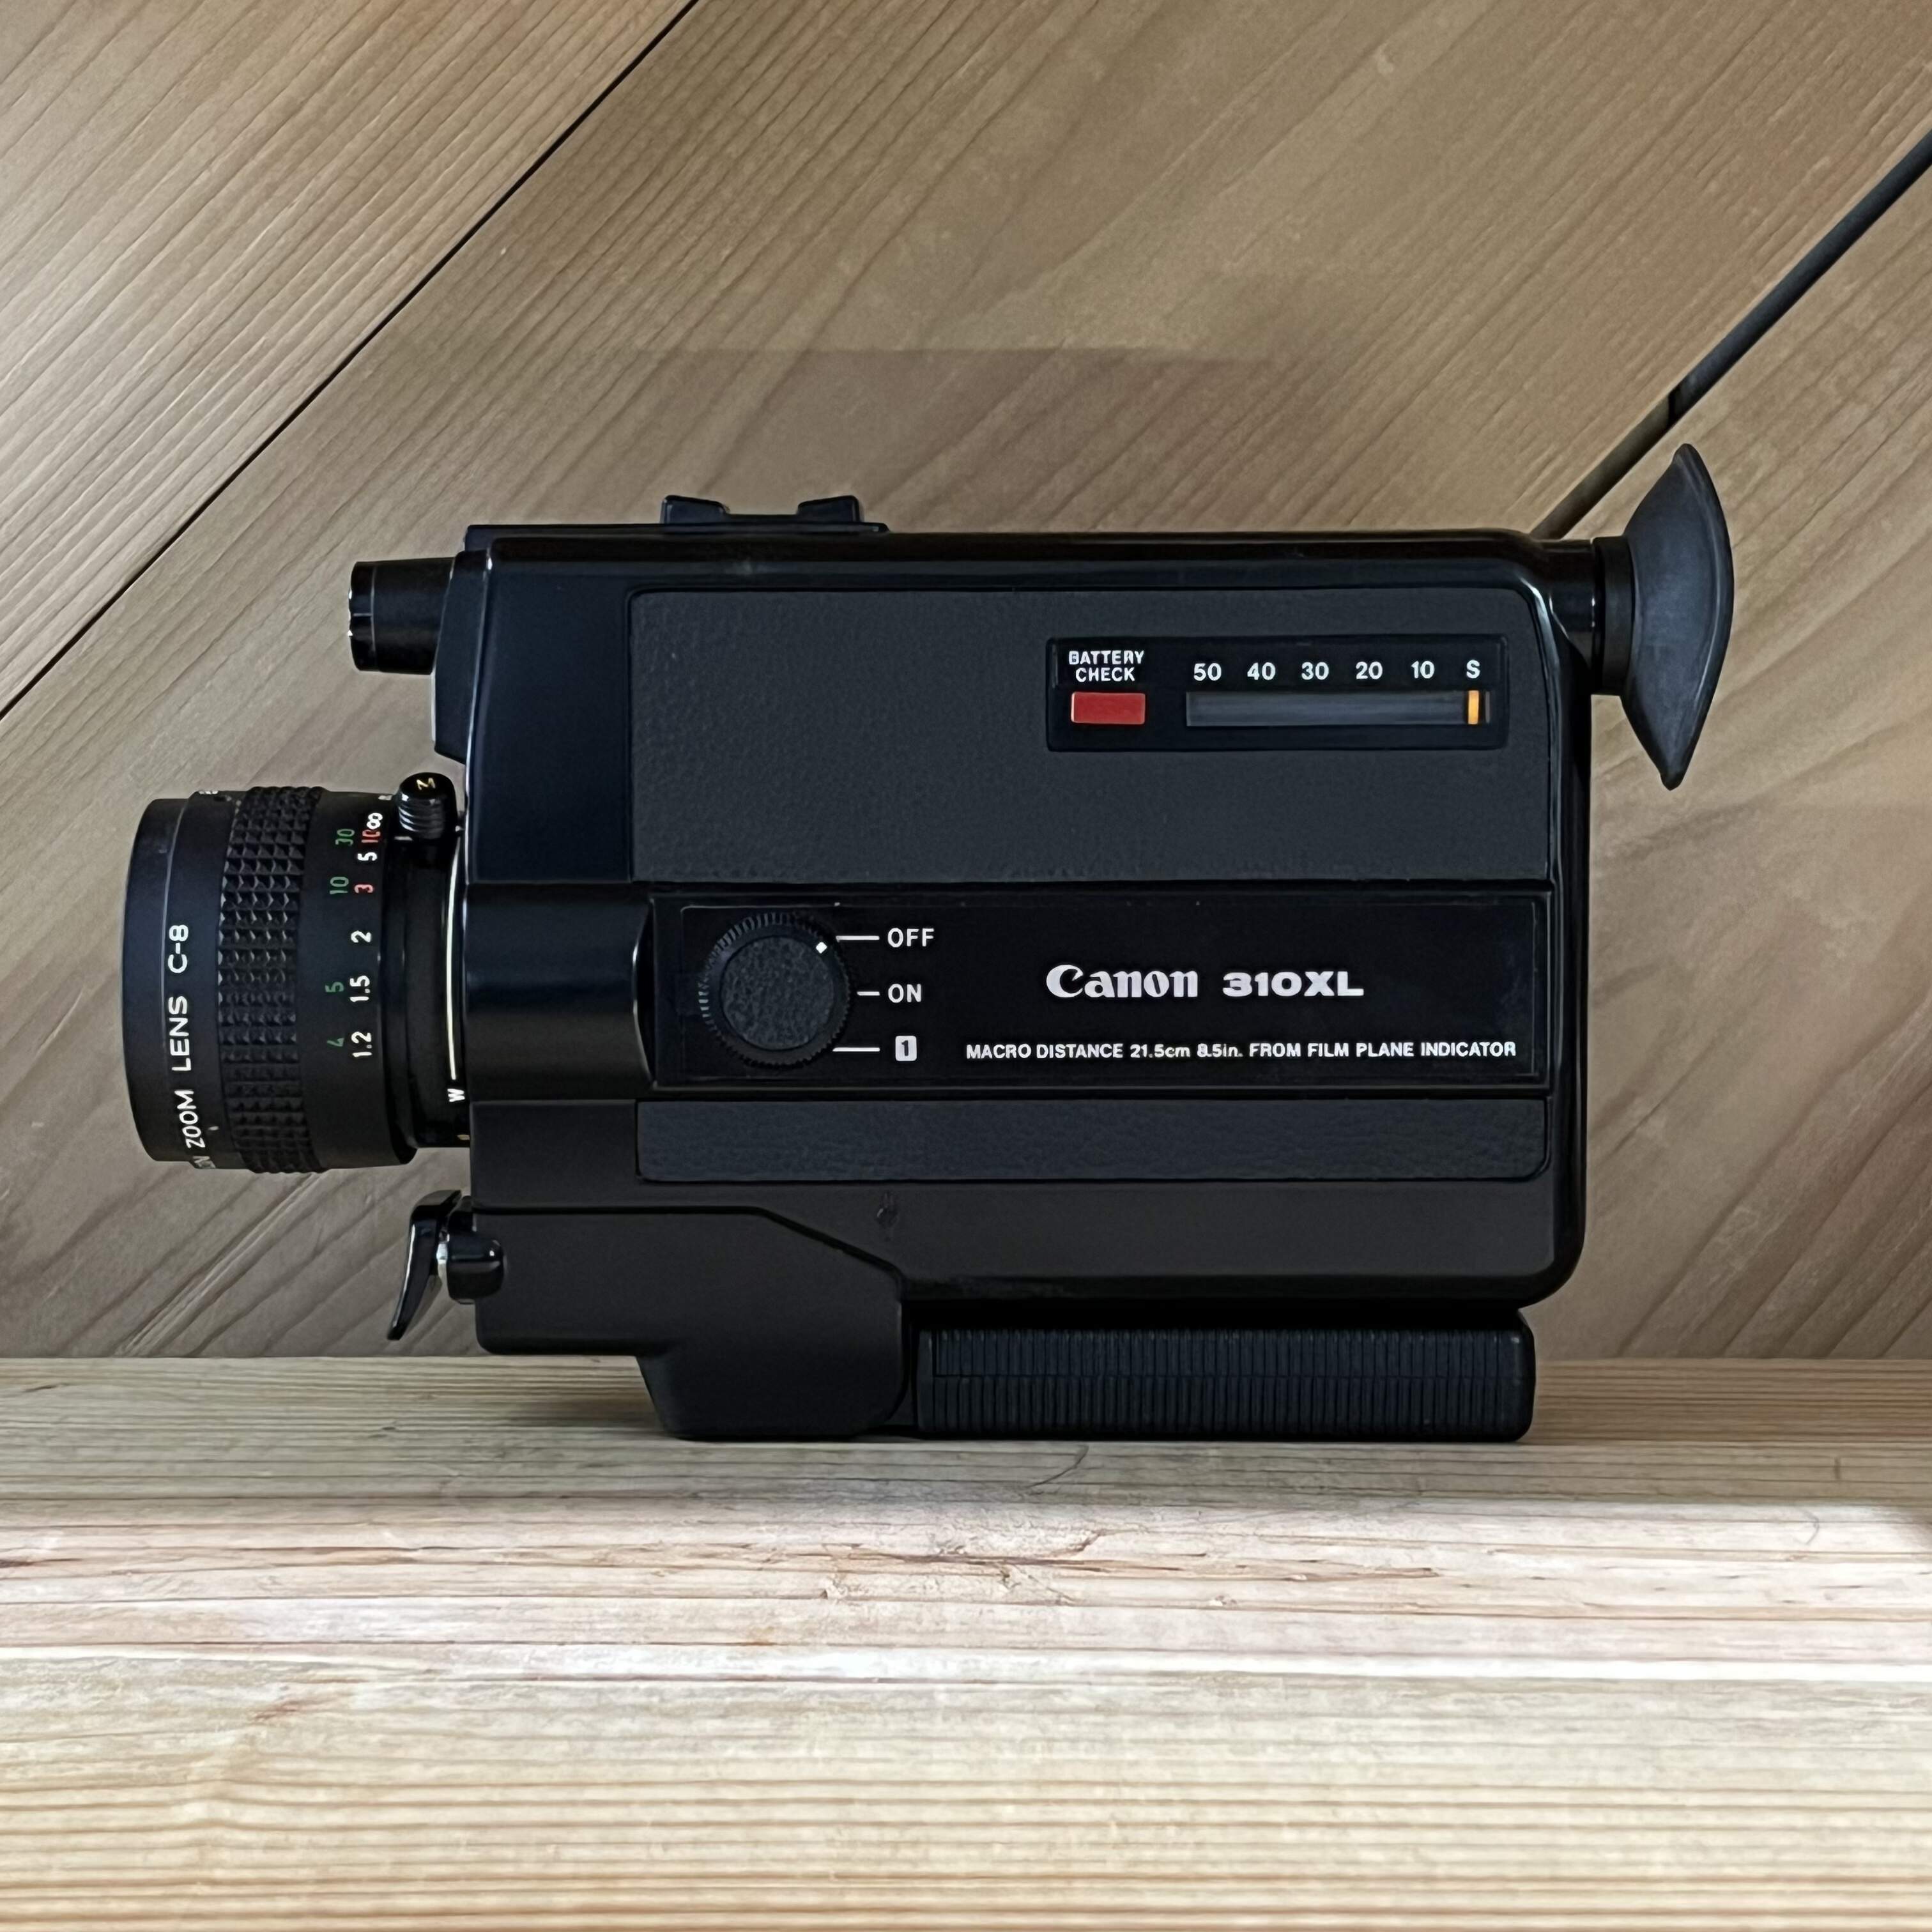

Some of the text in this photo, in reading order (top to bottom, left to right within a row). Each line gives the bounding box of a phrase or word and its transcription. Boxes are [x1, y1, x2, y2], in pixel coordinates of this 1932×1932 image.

[1068, 650, 1144, 665] BATTERY
[1075, 666, 1135, 682] CHECK
[1193, 659, 1480, 682] 50 40 30 20 10 S
[335, 829, 355, 847] 30
[357, 852, 378, 861] 5
[329, 876, 349, 895] 10
[354, 884, 374, 894] 3
[350, 930, 372, 944] 2
[887, 927, 935, 948] OFF
[167, 924, 189, 974] C-8
[325, 981, 344, 993] 5
[349, 975, 371, 1002] 1.5
[1046, 964, 1365, 998] Canon 310XL
[887, 983, 922, 1003] ON
[168, 995, 192, 1071] LENS
[326, 1038, 344, 1047] 4
[351, 1031, 372, 1057] 1.2
[966, 1043, 1032, 1059] MACRO
[1036, 1043, 1123, 1059] DISTANCE
[1249, 1042, 1301, 1057] FROM
[1307, 1042, 1349, 1057] FILM
[1356, 1041, 1414, 1057] PLANE
[1420, 1041, 1516, 1057] INDICATOR
[447, 1088, 465, 1102] W
[174, 1089, 206, 1149] ZOOM
